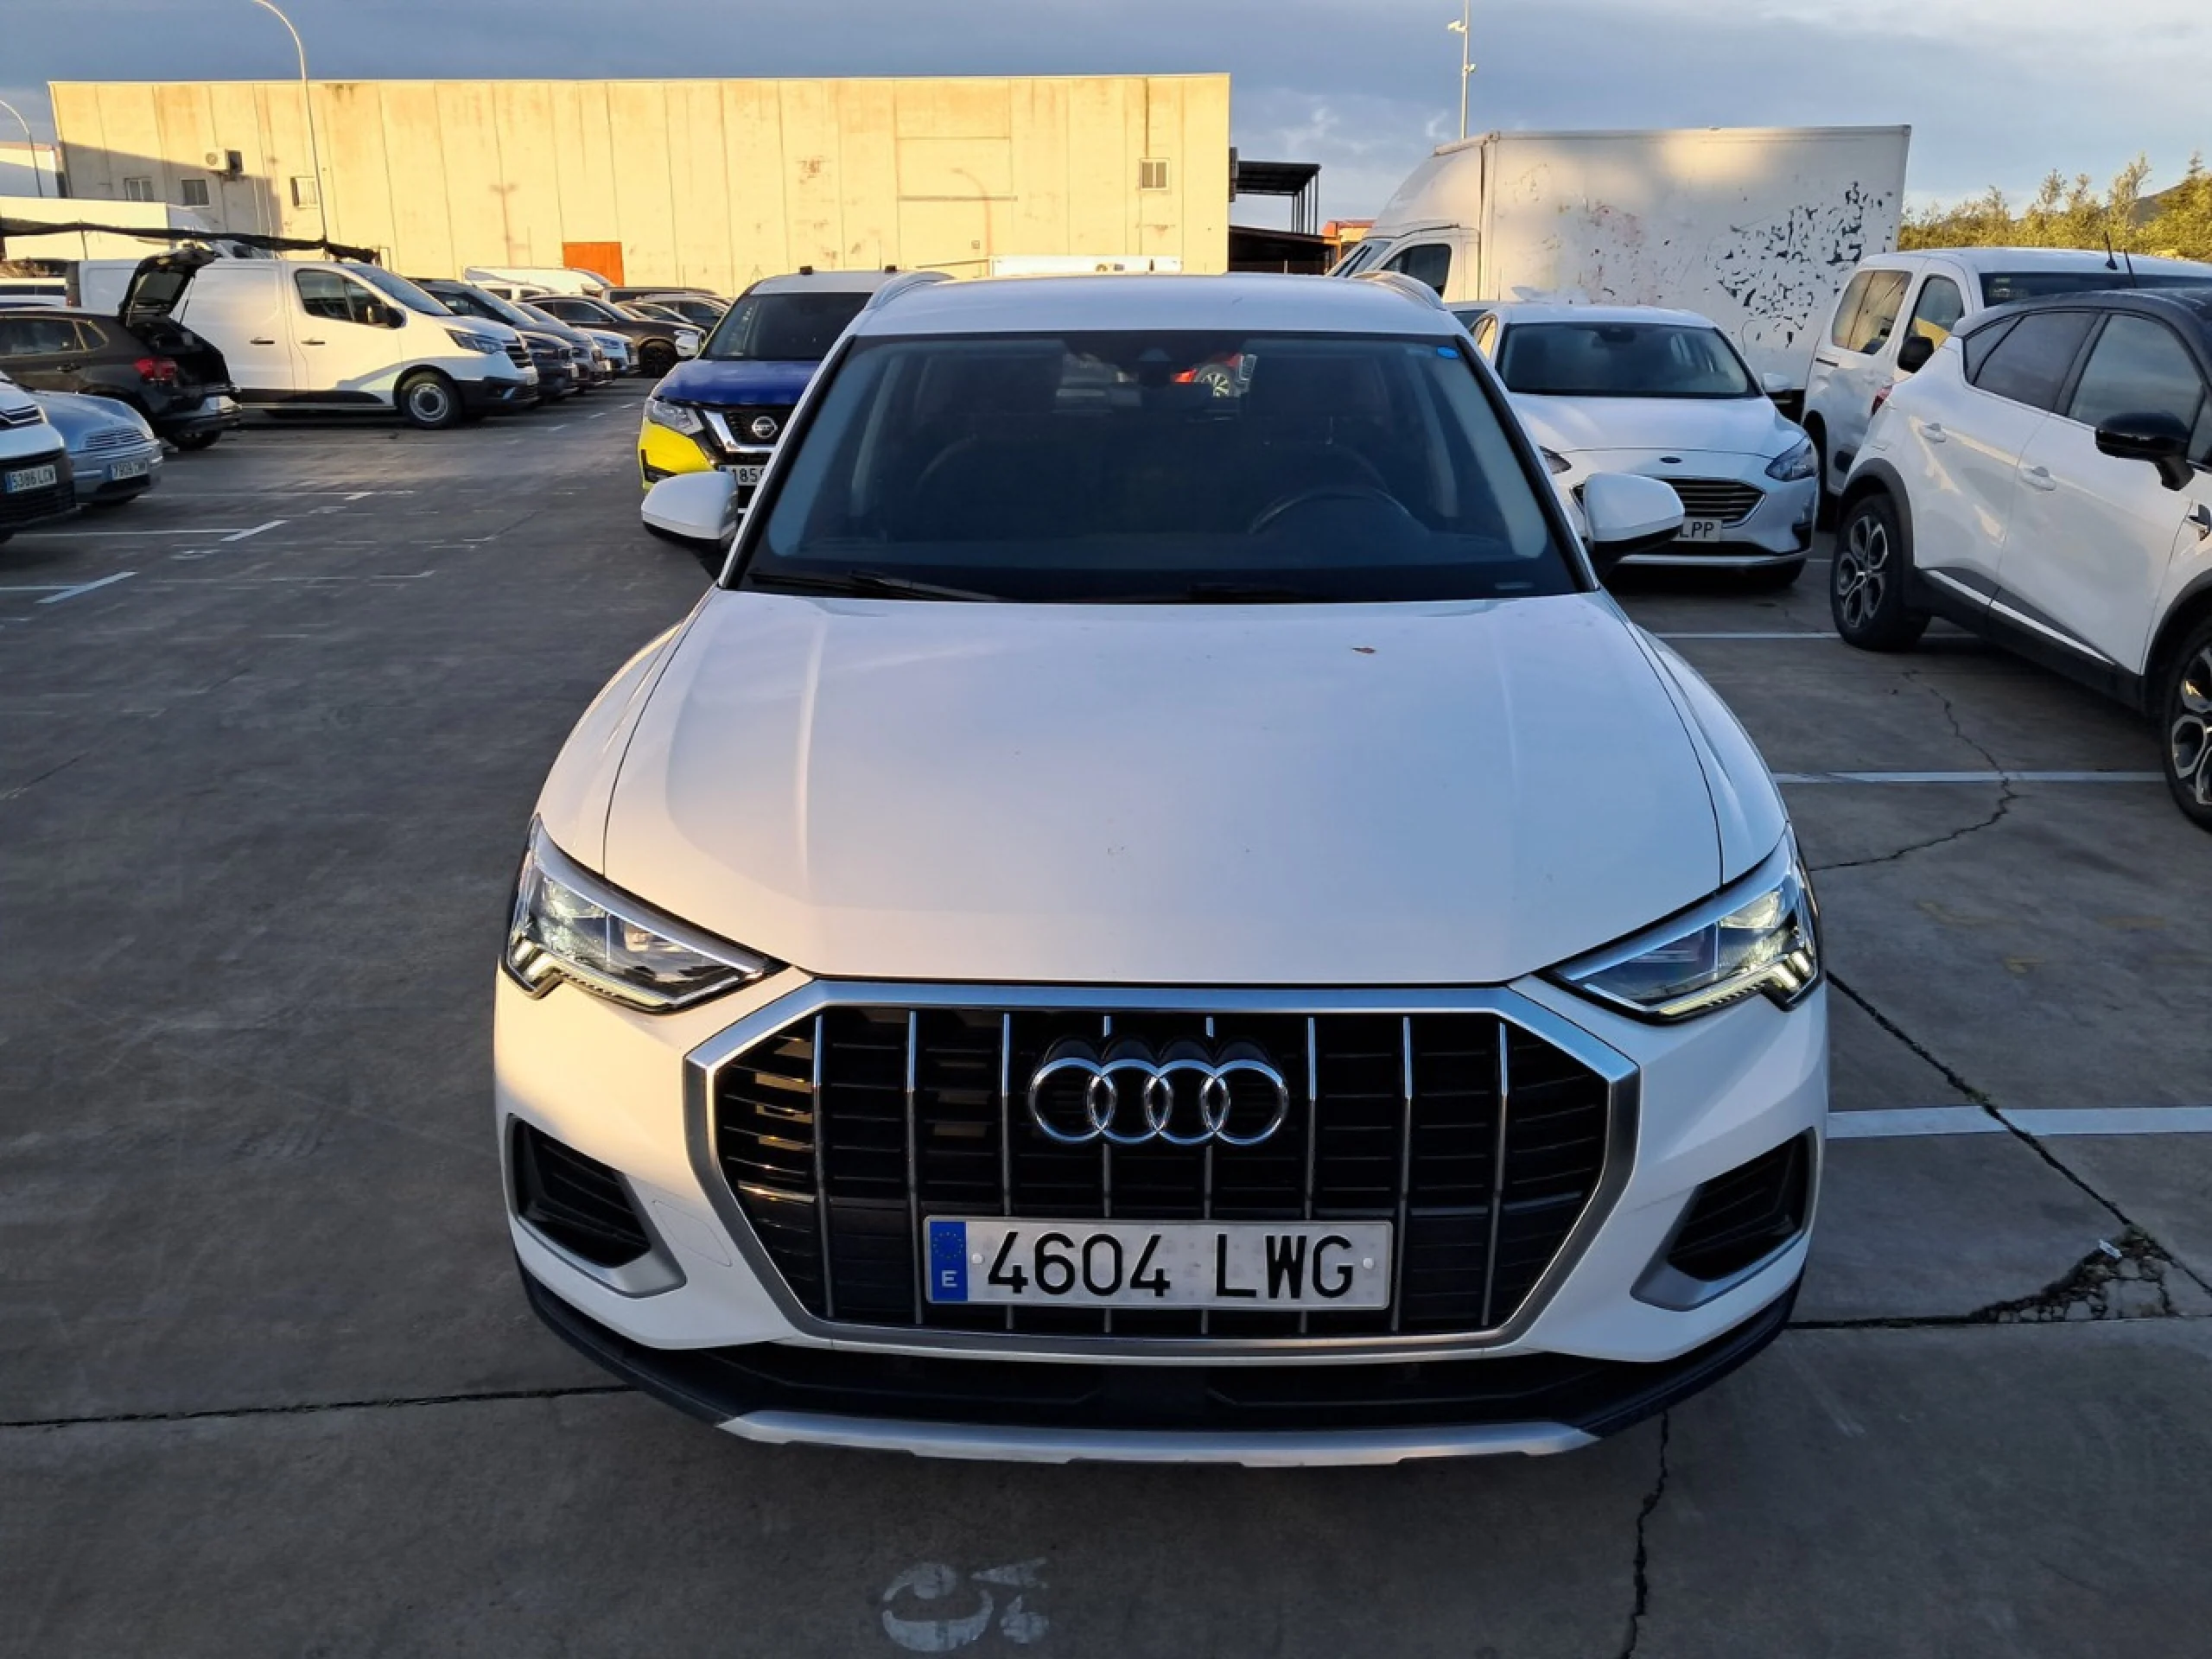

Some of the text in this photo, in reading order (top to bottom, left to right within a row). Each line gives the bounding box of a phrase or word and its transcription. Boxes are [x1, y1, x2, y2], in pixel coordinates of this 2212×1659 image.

[1680, 521, 1714, 537] LPP
[941, 1230, 1354, 1300] E 4604 LWG
